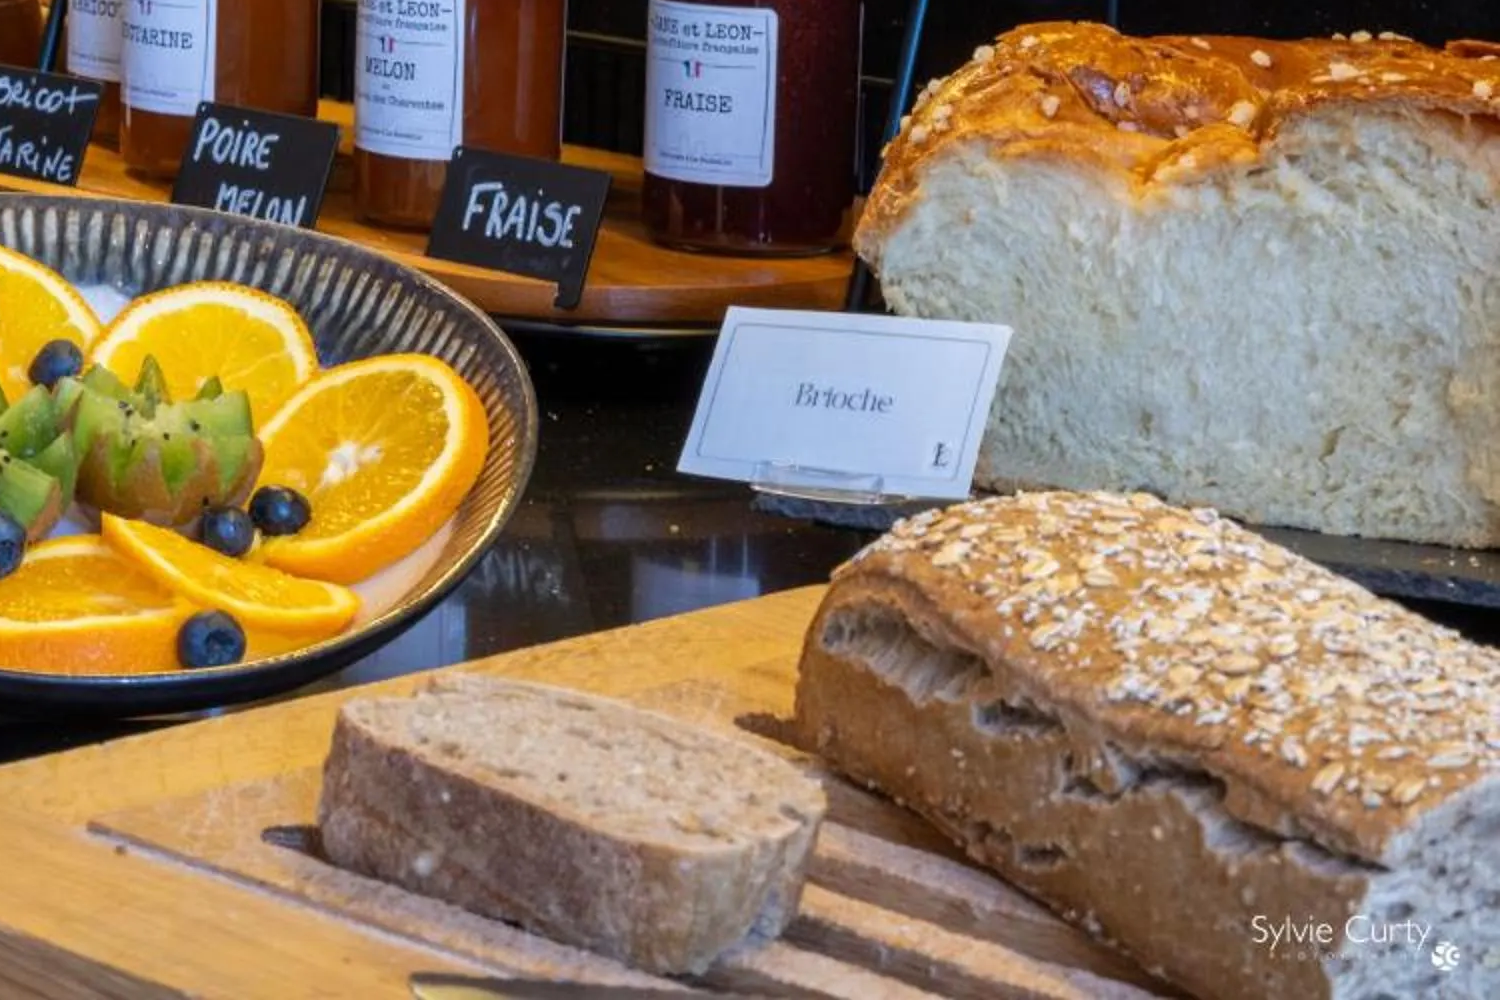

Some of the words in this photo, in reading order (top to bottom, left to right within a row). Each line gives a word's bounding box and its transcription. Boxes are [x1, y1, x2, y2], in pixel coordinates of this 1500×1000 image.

[663, 88, 734, 114] FRAISE
[193, 117, 280, 170] POIRE
[214, 180, 308, 228] MELON
[794, 381, 894, 414] Brioche
